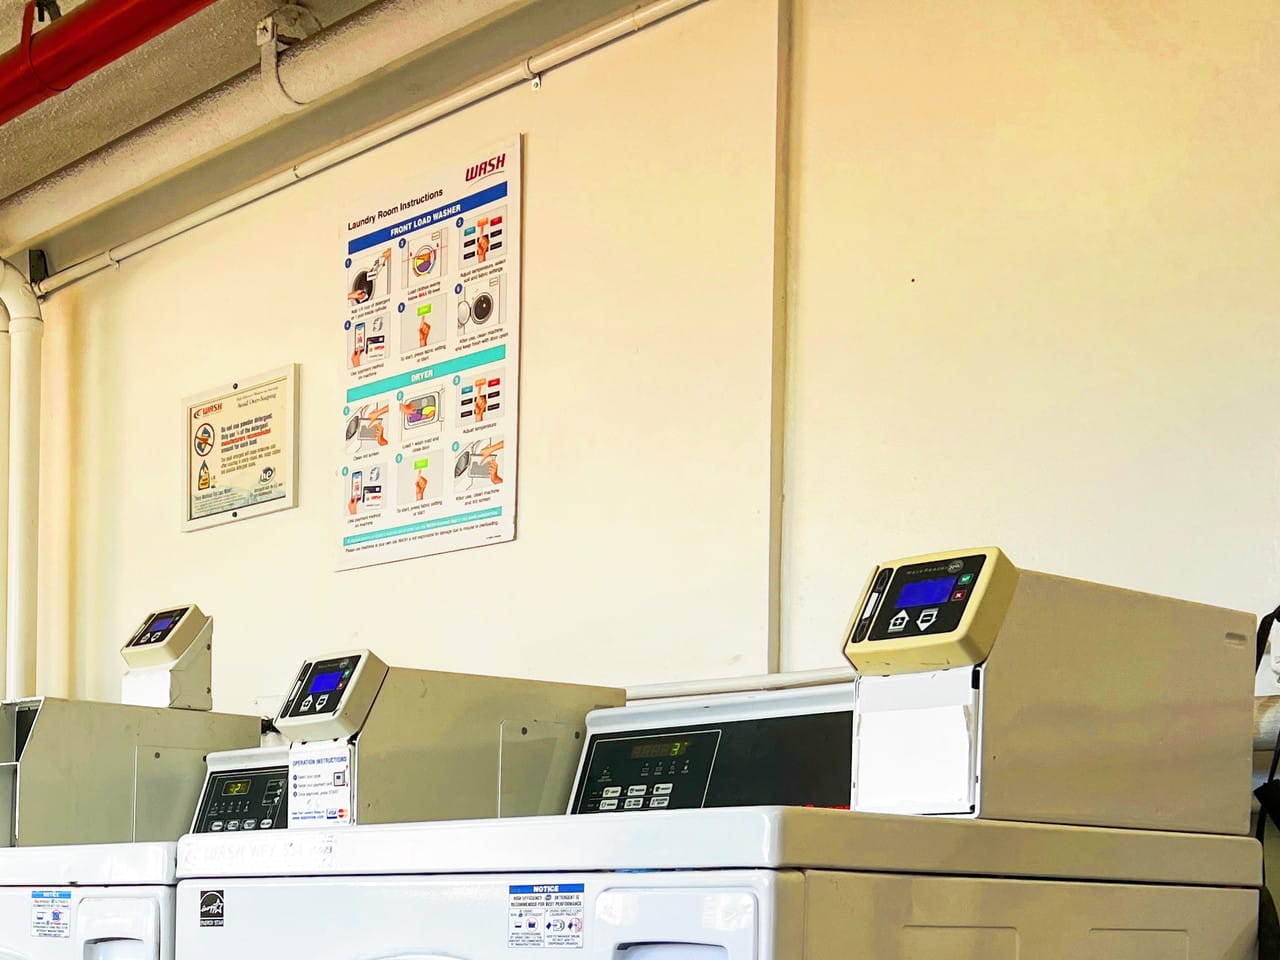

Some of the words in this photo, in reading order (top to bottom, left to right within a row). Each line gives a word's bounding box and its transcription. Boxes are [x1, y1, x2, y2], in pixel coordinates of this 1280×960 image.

[465, 153, 506, 182] WASH
[348, 214, 376, 231] Laundry
[377, 205, 399, 220] Room
[400, 189, 444, 211] Instructions
[390, 222, 412, 237] FRONT
[413, 216, 432, 228] LOAD
[432, 204, 461, 221] WASHER
[411, 369, 433, 383] DRYER
[202, 402, 223, 415] WASH
[292, 759, 315, 767] OPERATION
[316, 756, 347, 765] INSTRUCTIONS
[533, 885, 560, 893] NOTICE
